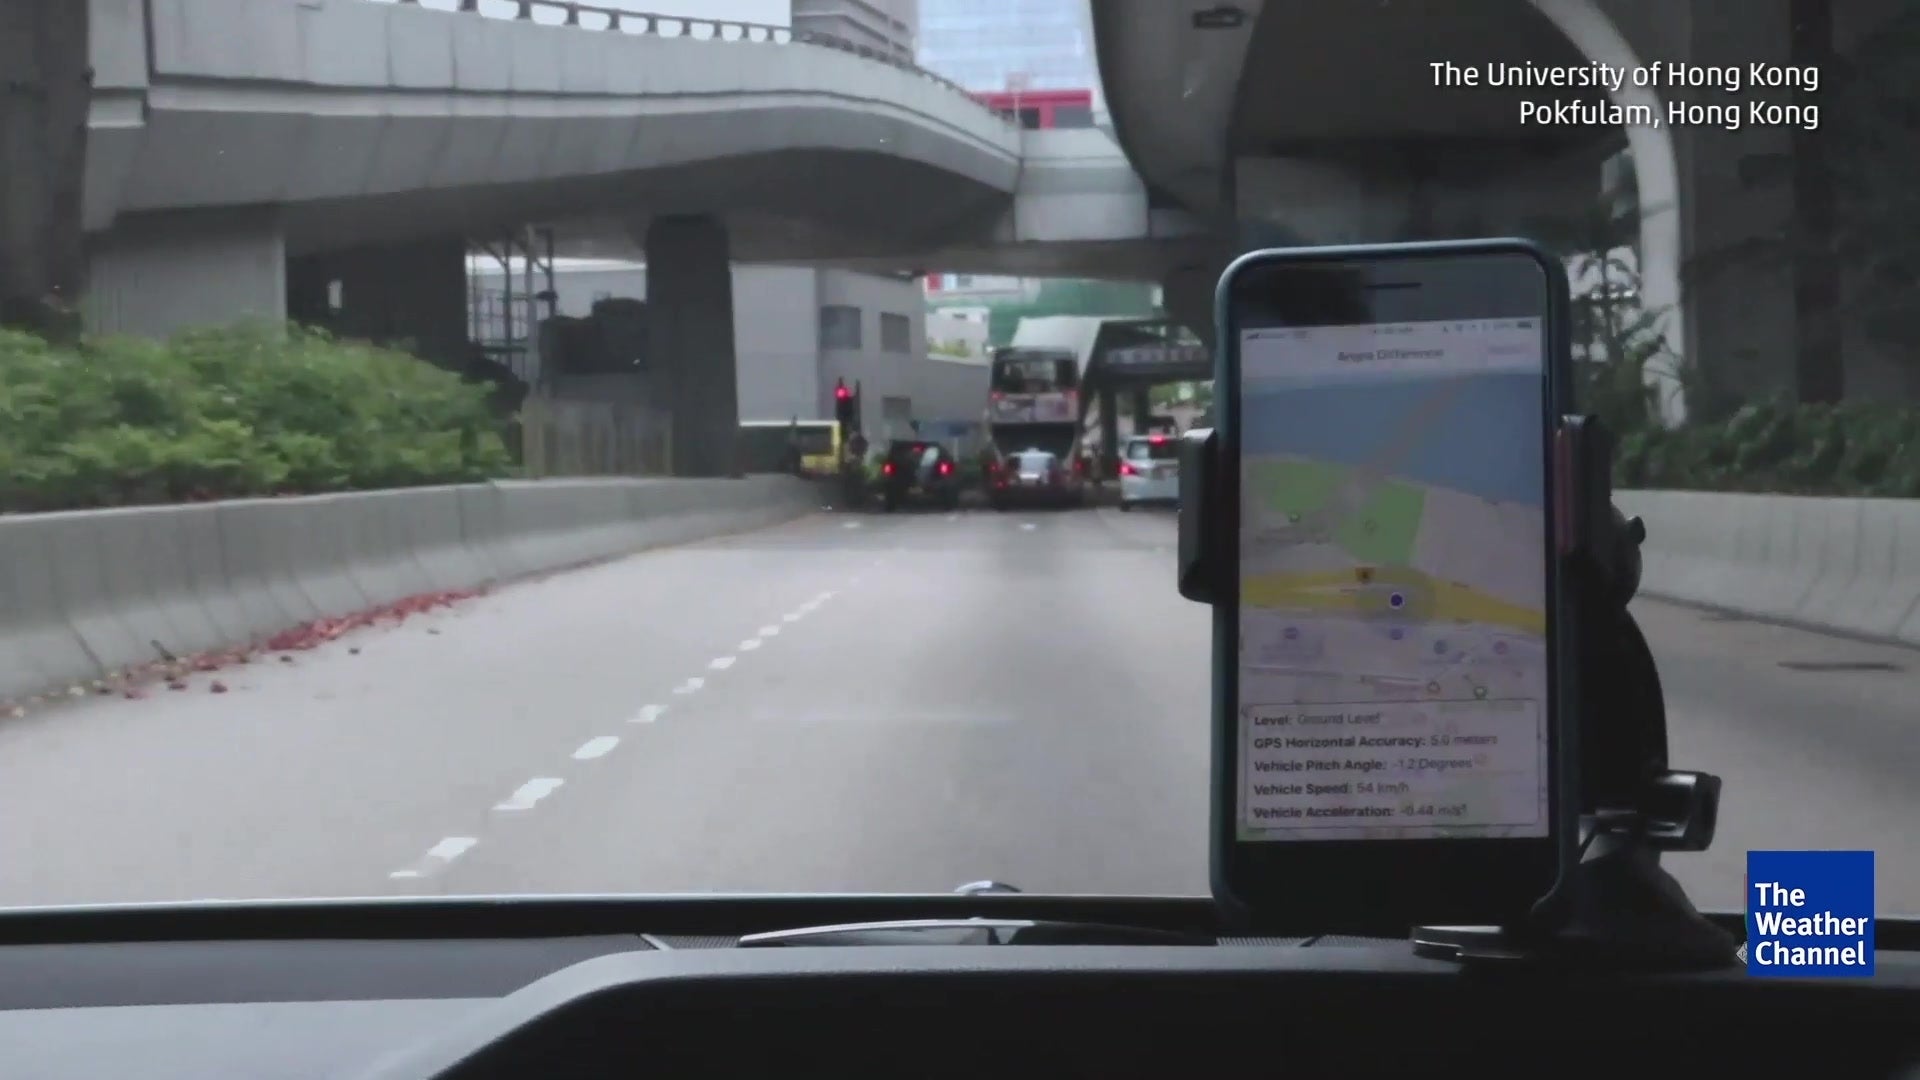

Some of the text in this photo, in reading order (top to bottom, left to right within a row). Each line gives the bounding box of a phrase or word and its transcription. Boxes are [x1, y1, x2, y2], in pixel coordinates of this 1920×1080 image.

[1254, 737, 1282, 749] GPS
[1286, 736, 1356, 748] Horizontal
[1358, 735, 1426, 748] Accuracy:
[1254, 759, 1303, 772] Vehicle
[1306, 759, 1340, 771] Pitch
[1343, 759, 1387, 773] Angle:
[1254, 781, 1409, 796] Vehicle Speed: 54 km/h
[1253, 806, 1303, 819] Vehicle
[1306, 805, 1396, 818] Acceleration:
